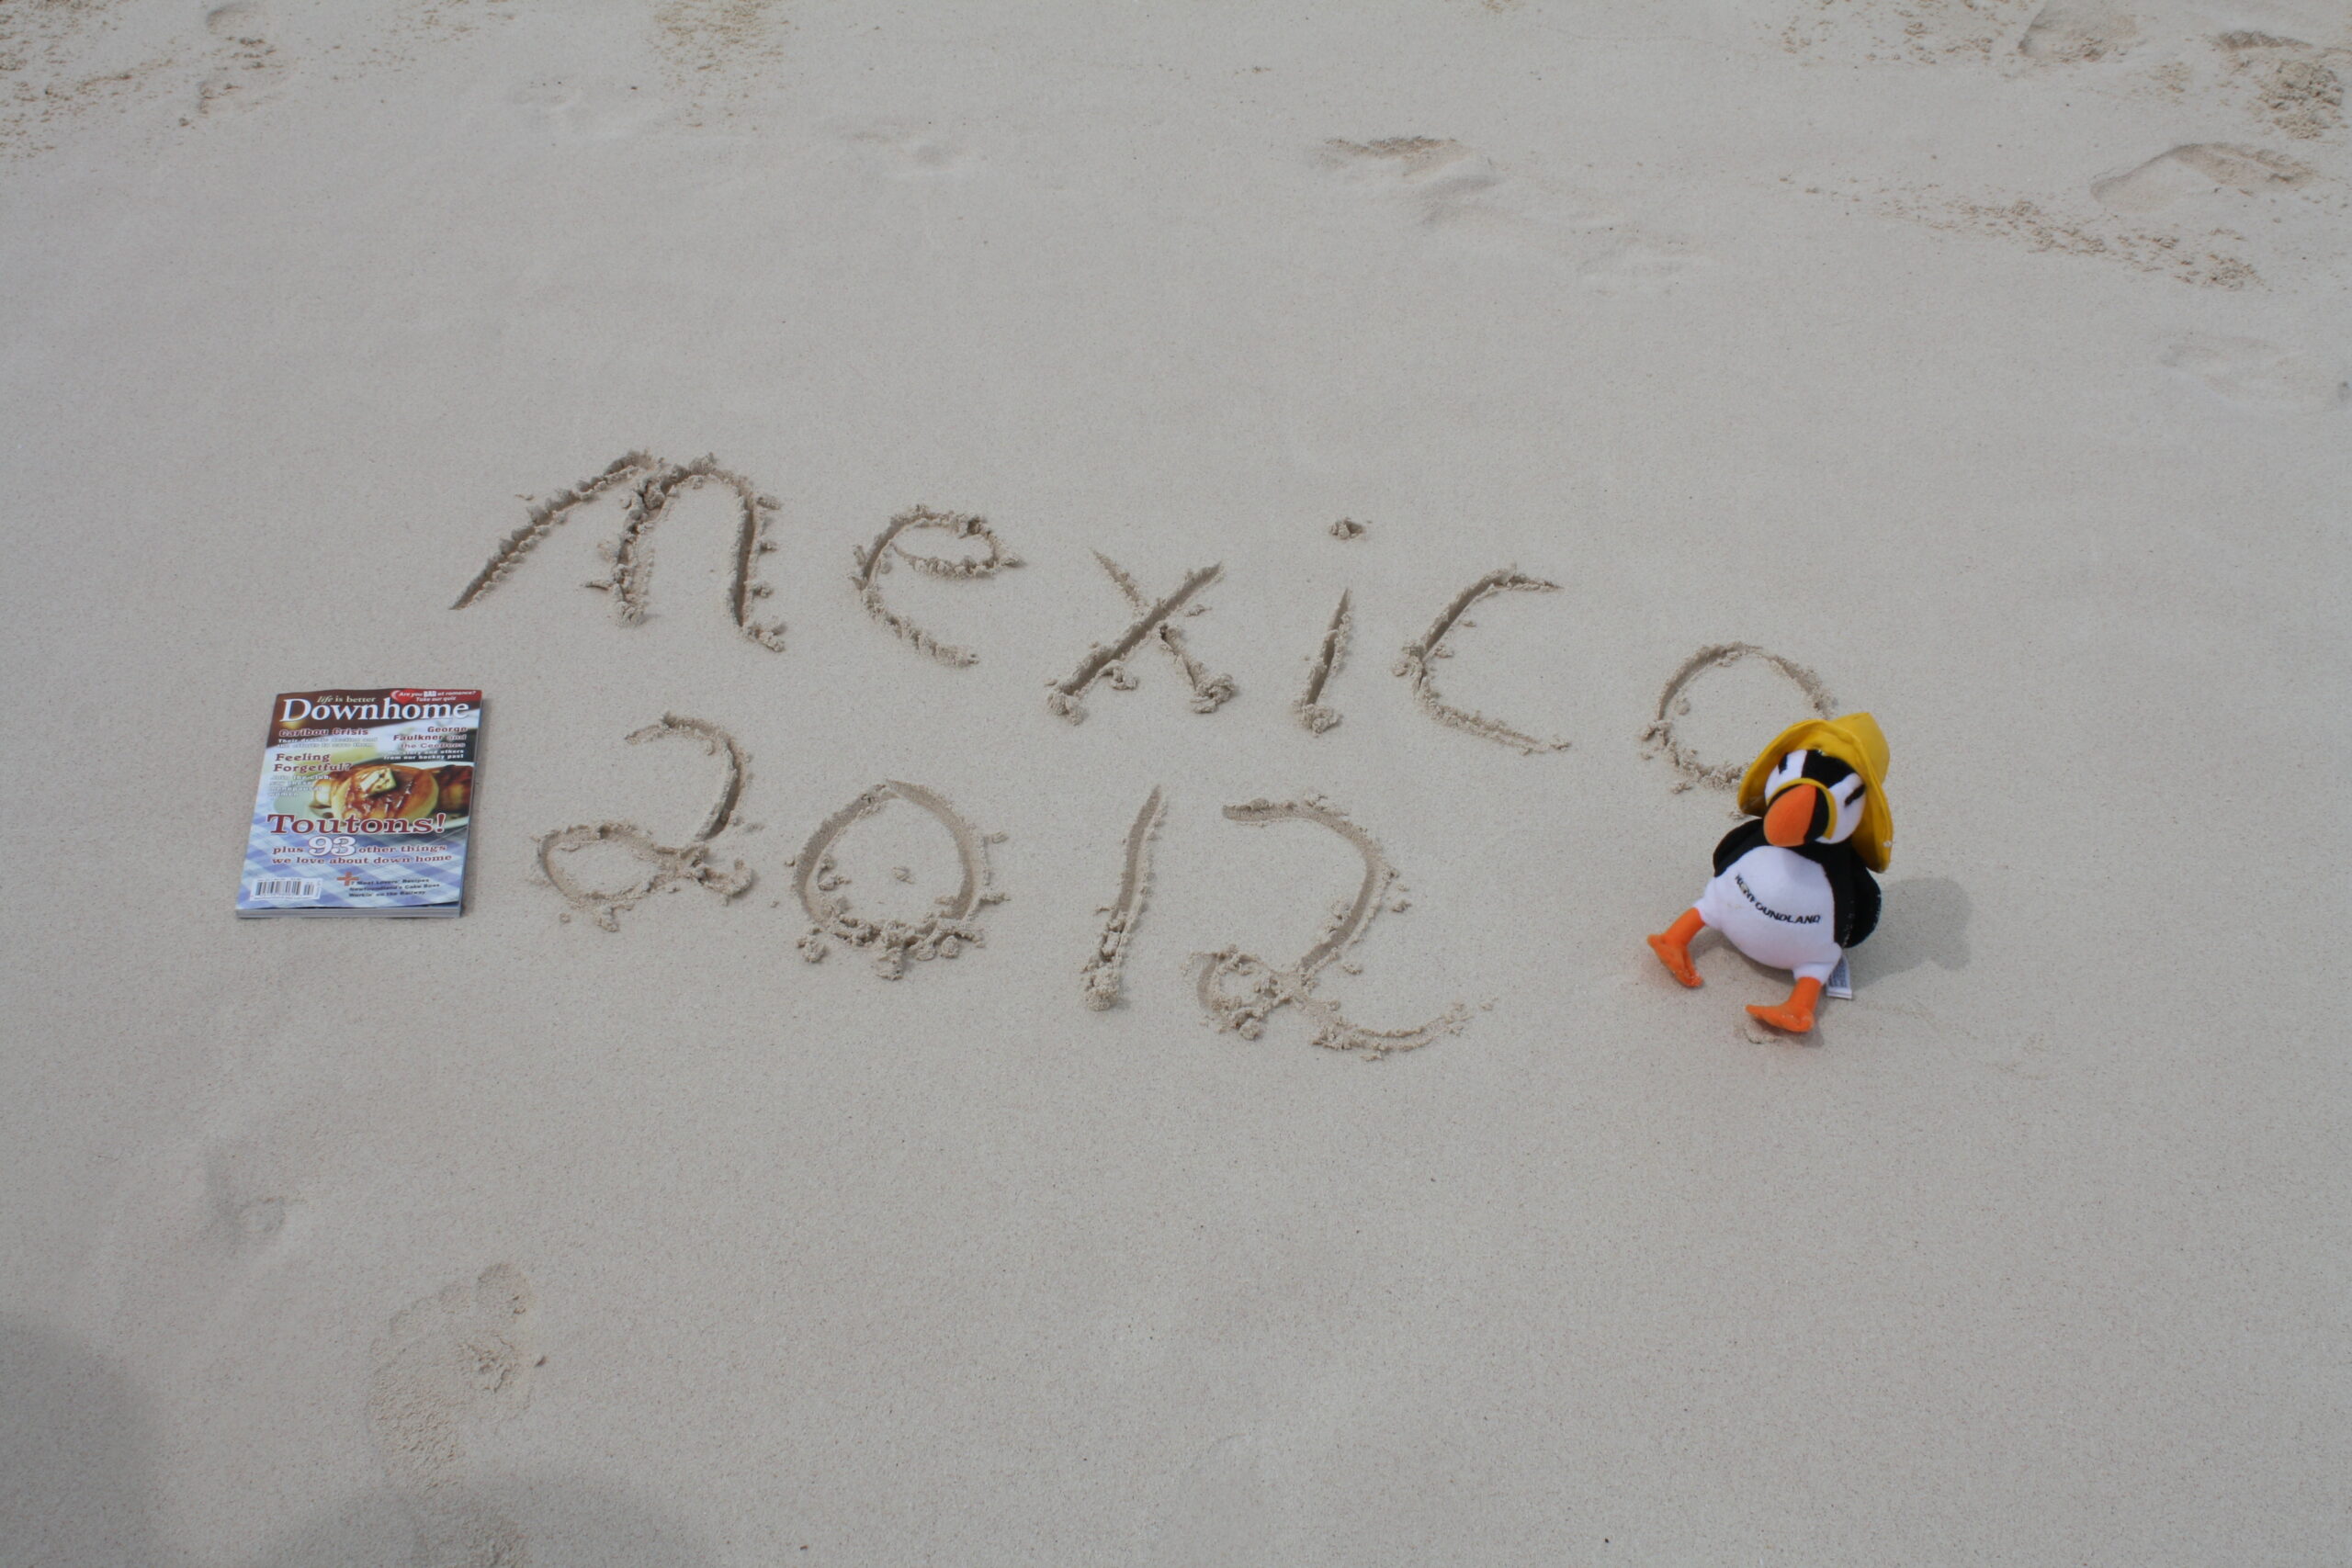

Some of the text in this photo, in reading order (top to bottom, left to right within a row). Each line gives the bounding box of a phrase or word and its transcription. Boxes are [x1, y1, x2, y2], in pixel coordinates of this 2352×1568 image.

[317, 695, 334, 704] life
[346, 694, 376, 703] better
[279, 697, 469, 722] Downhome
[278, 727, 369, 738] Caribou Crisis
[275, 753, 331, 762] Feeling
[273, 762, 353, 773] Forgetful?
[267, 813, 447, 834] Toutons!
[272, 835, 447, 856] plus 93 other things
[415, 854, 452, 863] home
[535, 713, 1477, 1061] 2012
